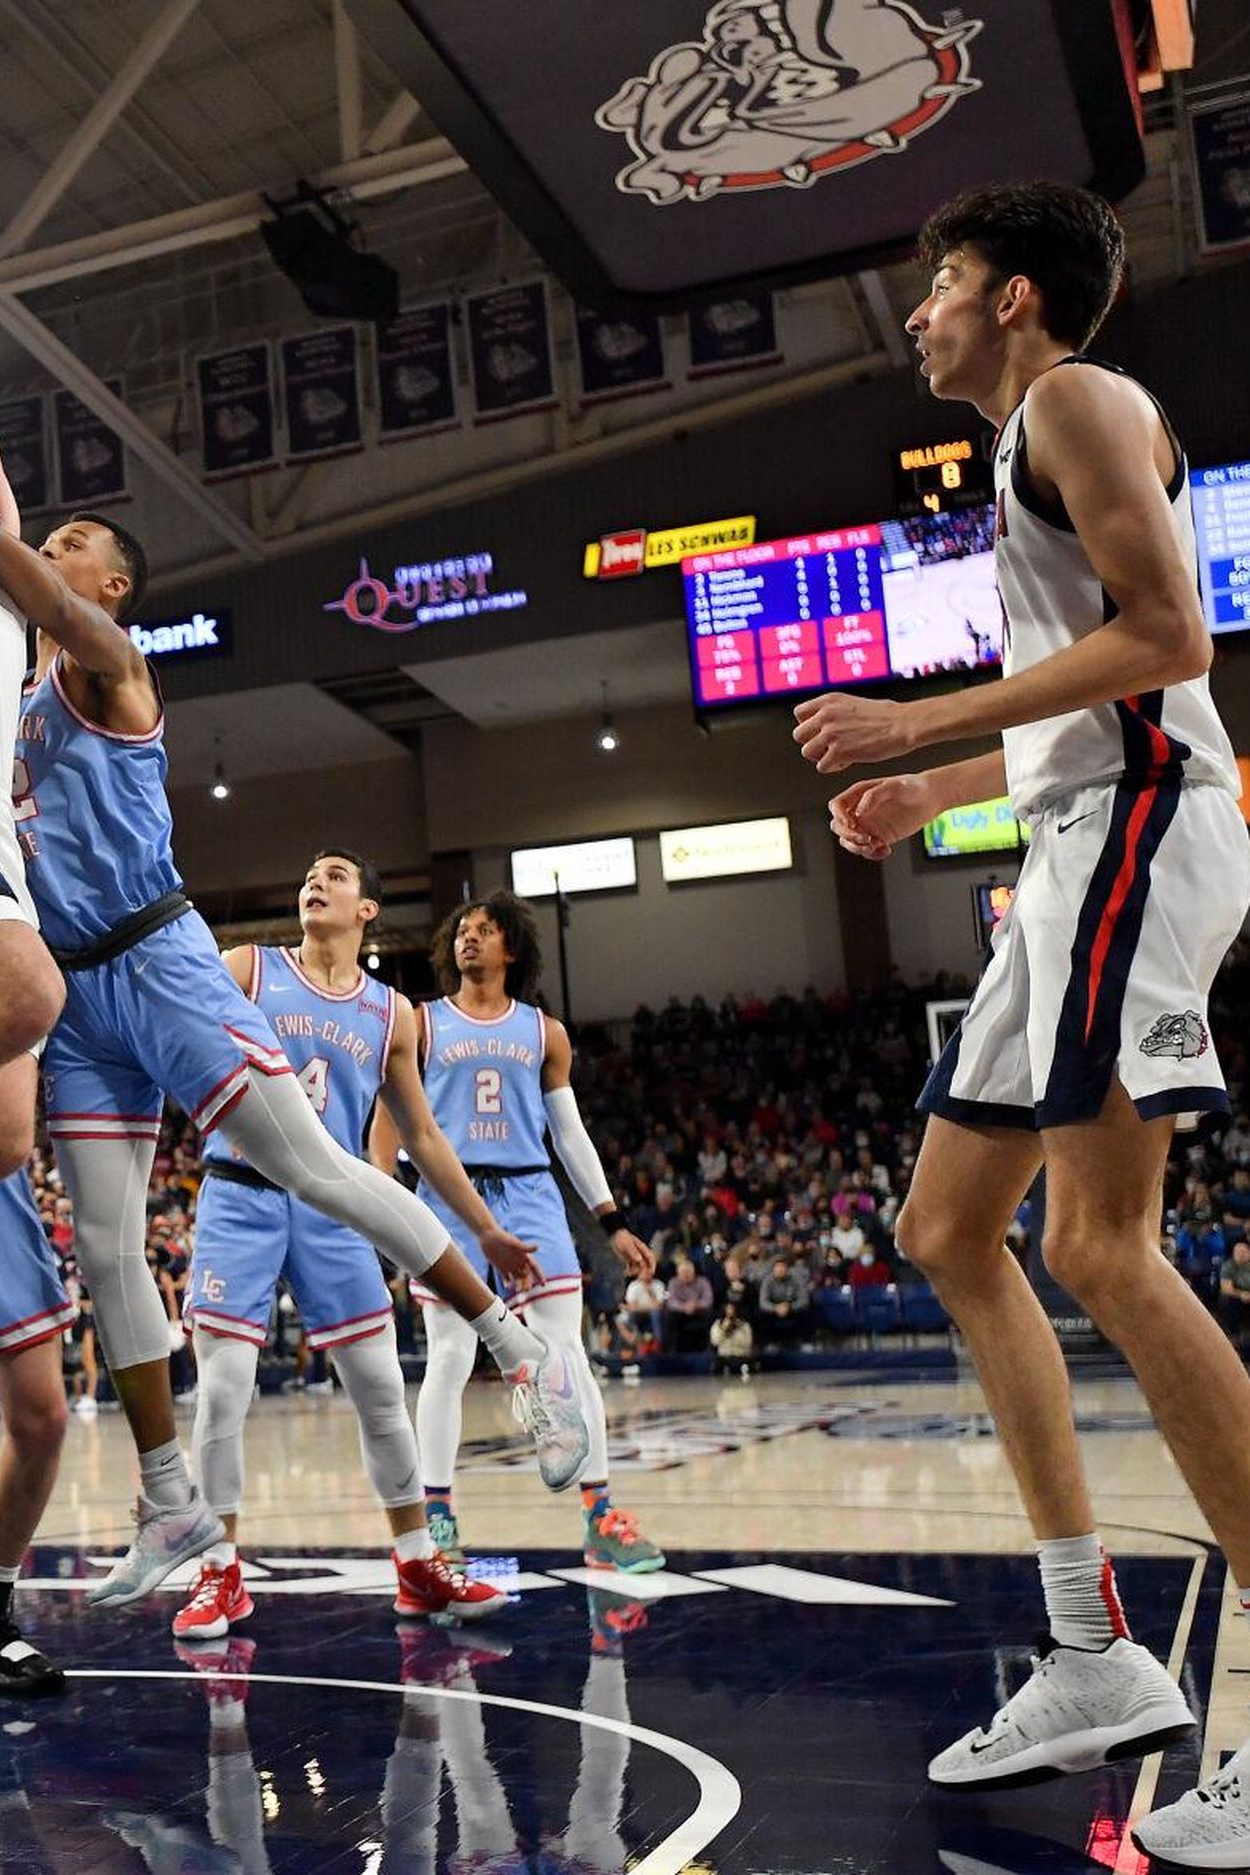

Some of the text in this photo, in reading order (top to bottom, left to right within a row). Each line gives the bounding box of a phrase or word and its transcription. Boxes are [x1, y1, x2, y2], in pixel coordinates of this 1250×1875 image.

[923, 494, 939, 512] 4
[129, 613, 219, 655] bank
[298, 1056, 332, 1114] 4
[475, 1067, 503, 1116] 2
[469, 1120, 509, 1142] STATE
